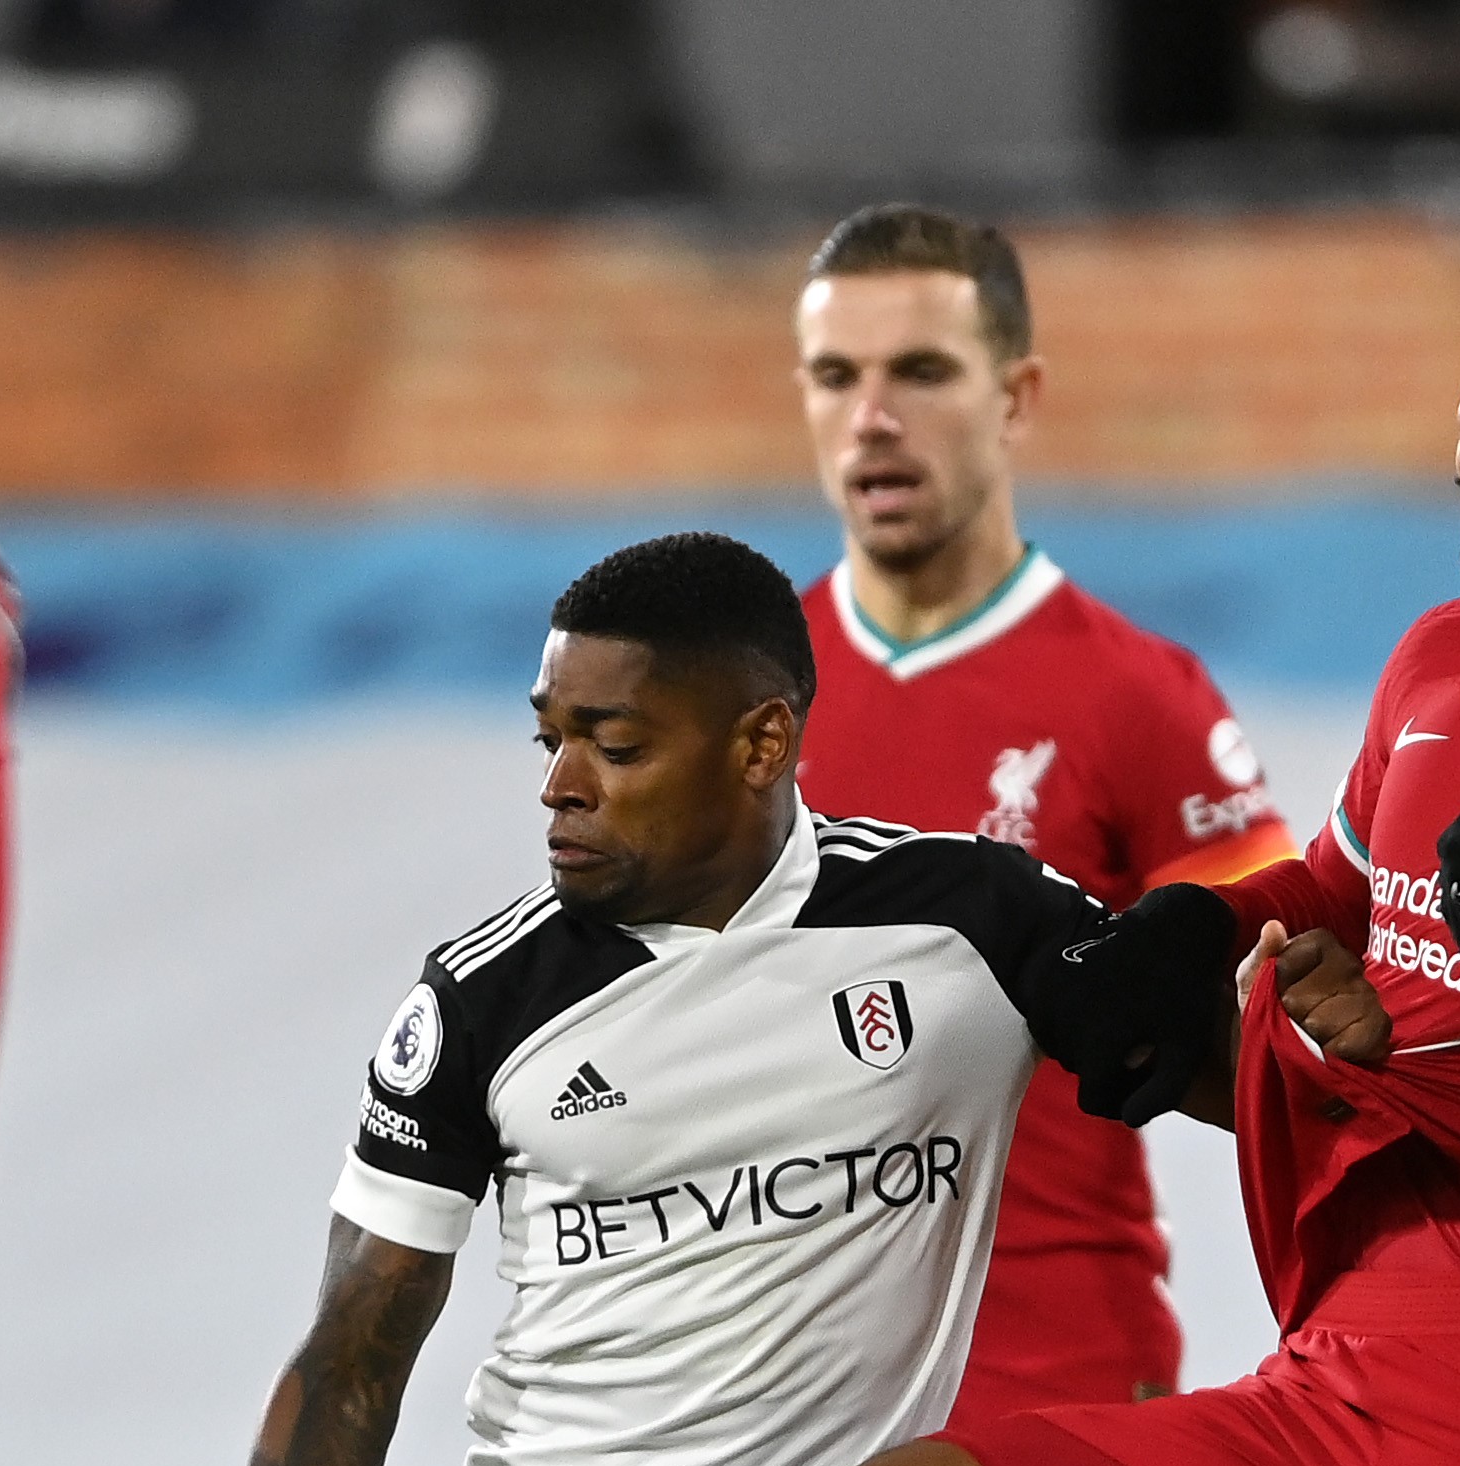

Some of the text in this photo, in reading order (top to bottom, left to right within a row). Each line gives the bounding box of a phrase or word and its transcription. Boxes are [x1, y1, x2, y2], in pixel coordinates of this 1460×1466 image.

[856, 991, 895, 1052] FFC
[372, 1099, 419, 1136] room
[550, 1091, 628, 1120] adidas
[550, 1136, 962, 1266] BETVICTOR
